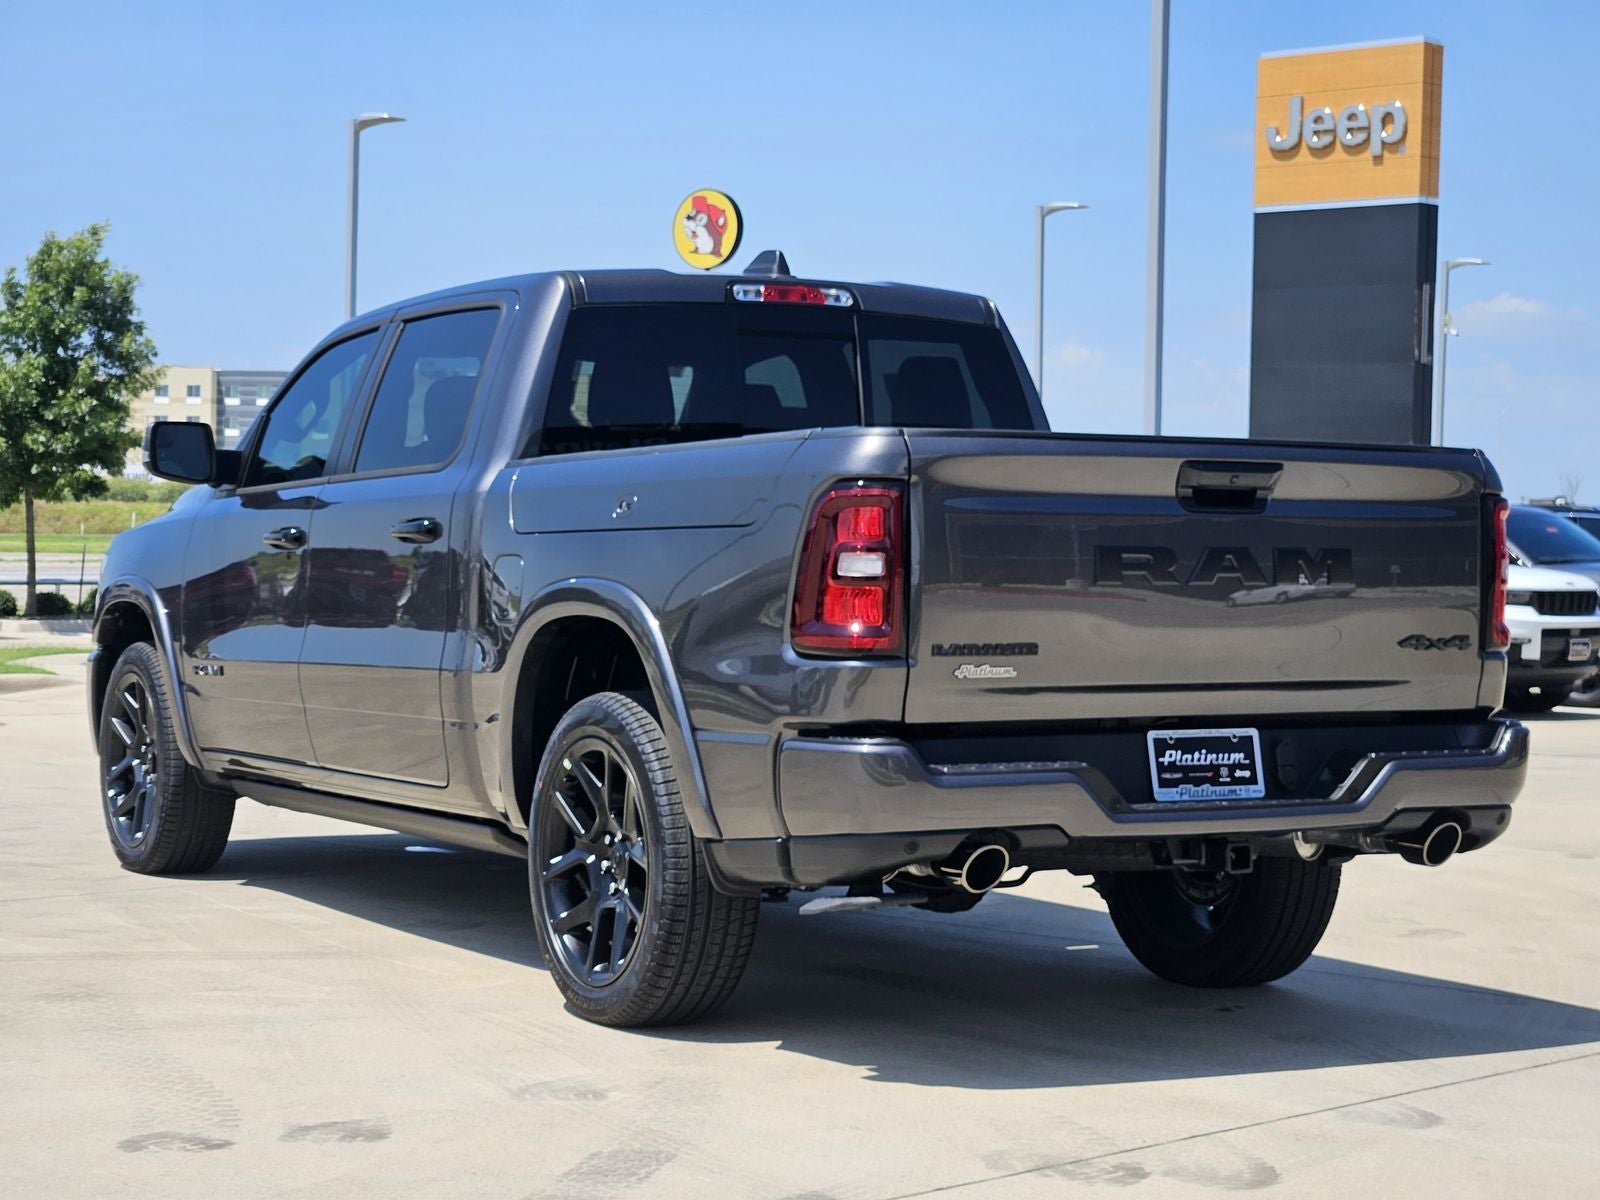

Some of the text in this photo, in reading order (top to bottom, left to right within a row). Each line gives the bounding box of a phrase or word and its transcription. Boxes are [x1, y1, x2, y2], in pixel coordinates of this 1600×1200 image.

[1266, 95, 1408, 157] Jeep
[1093, 546, 1352, 586] RAM
[1397, 634, 1470, 651] 4x4
[955, 664, 1017, 679] Platinum
[1158, 749, 1250, 766] Platinum
[1178, 785, 1241, 799] Platinum
